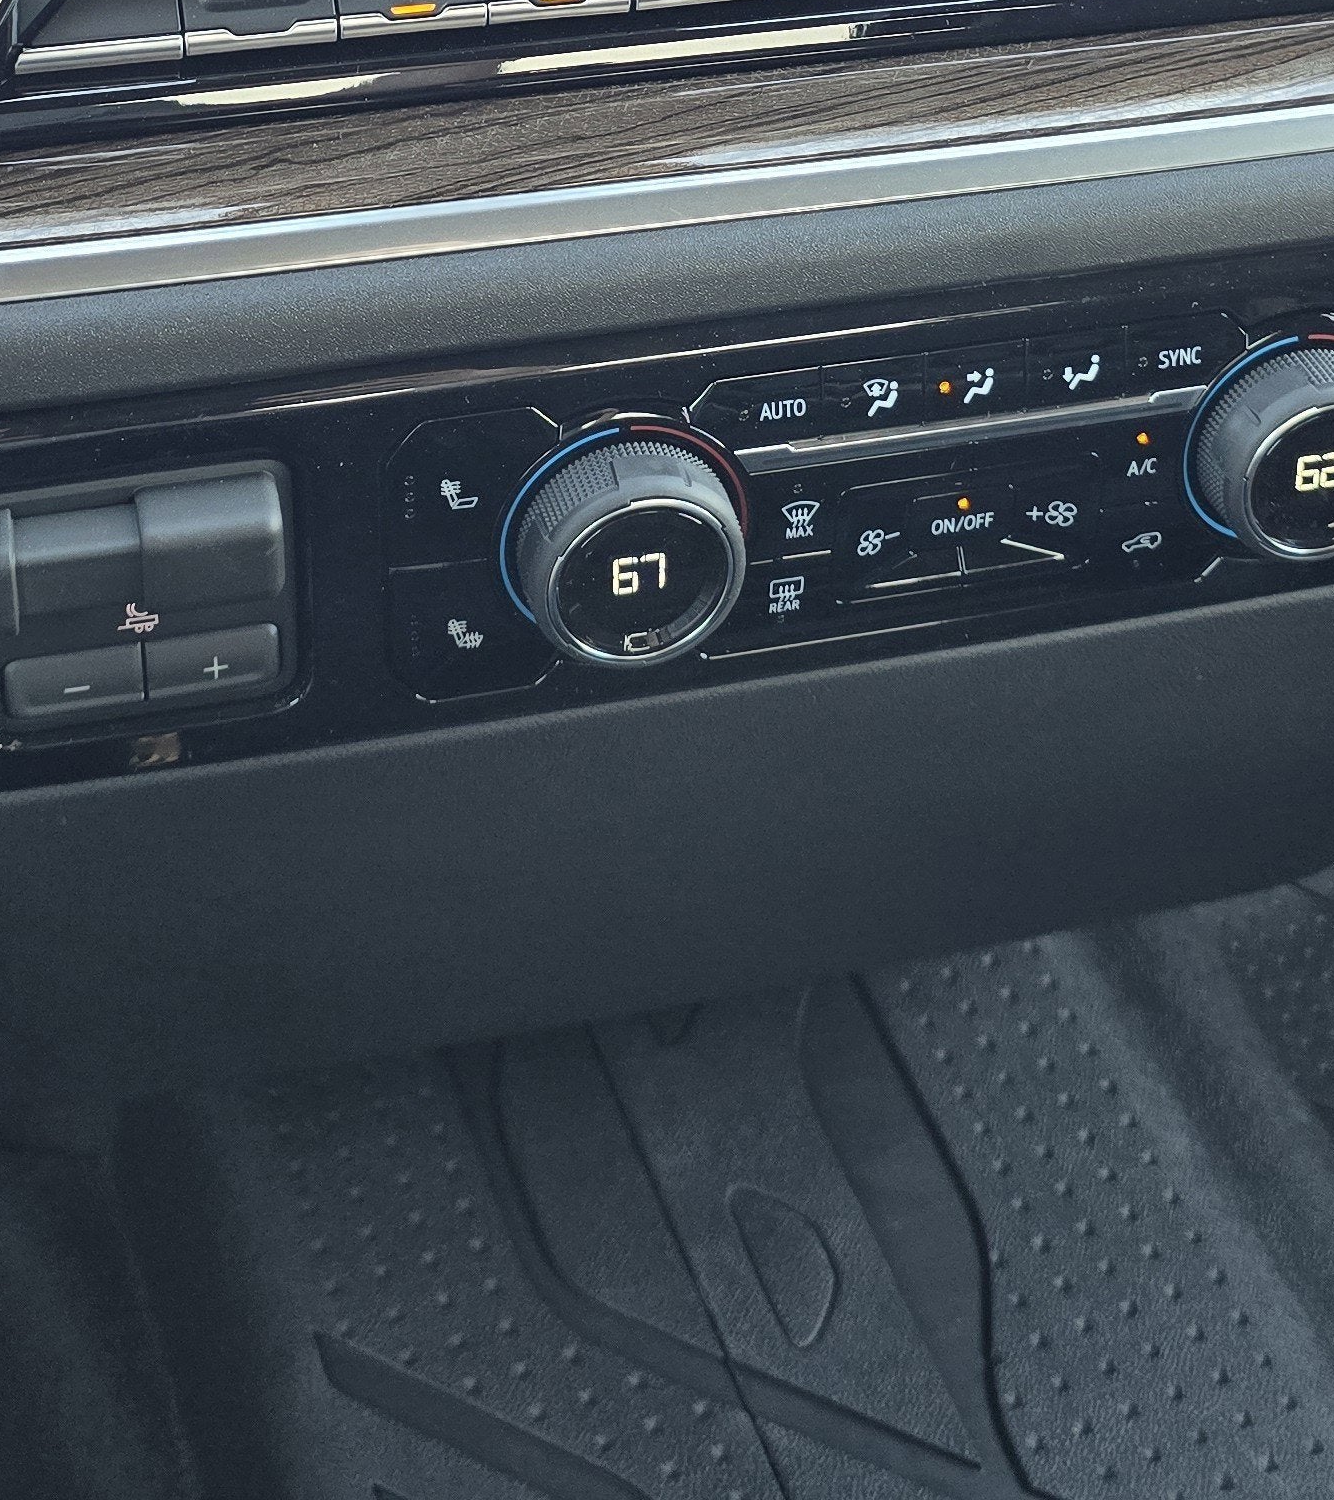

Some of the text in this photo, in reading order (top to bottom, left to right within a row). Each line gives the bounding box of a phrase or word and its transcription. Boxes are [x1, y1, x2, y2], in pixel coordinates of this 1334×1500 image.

[1157, 345, 1202, 370] SYNC
[759, 398, 807, 422] AUTO
[1126, 457, 1157, 478] A/C
[785, 523, 814, 540] MAX
[930, 511, 995, 536] ON/OFF
[612, 552, 666, 596] 67
[768, 599, 800, 614] REAR
